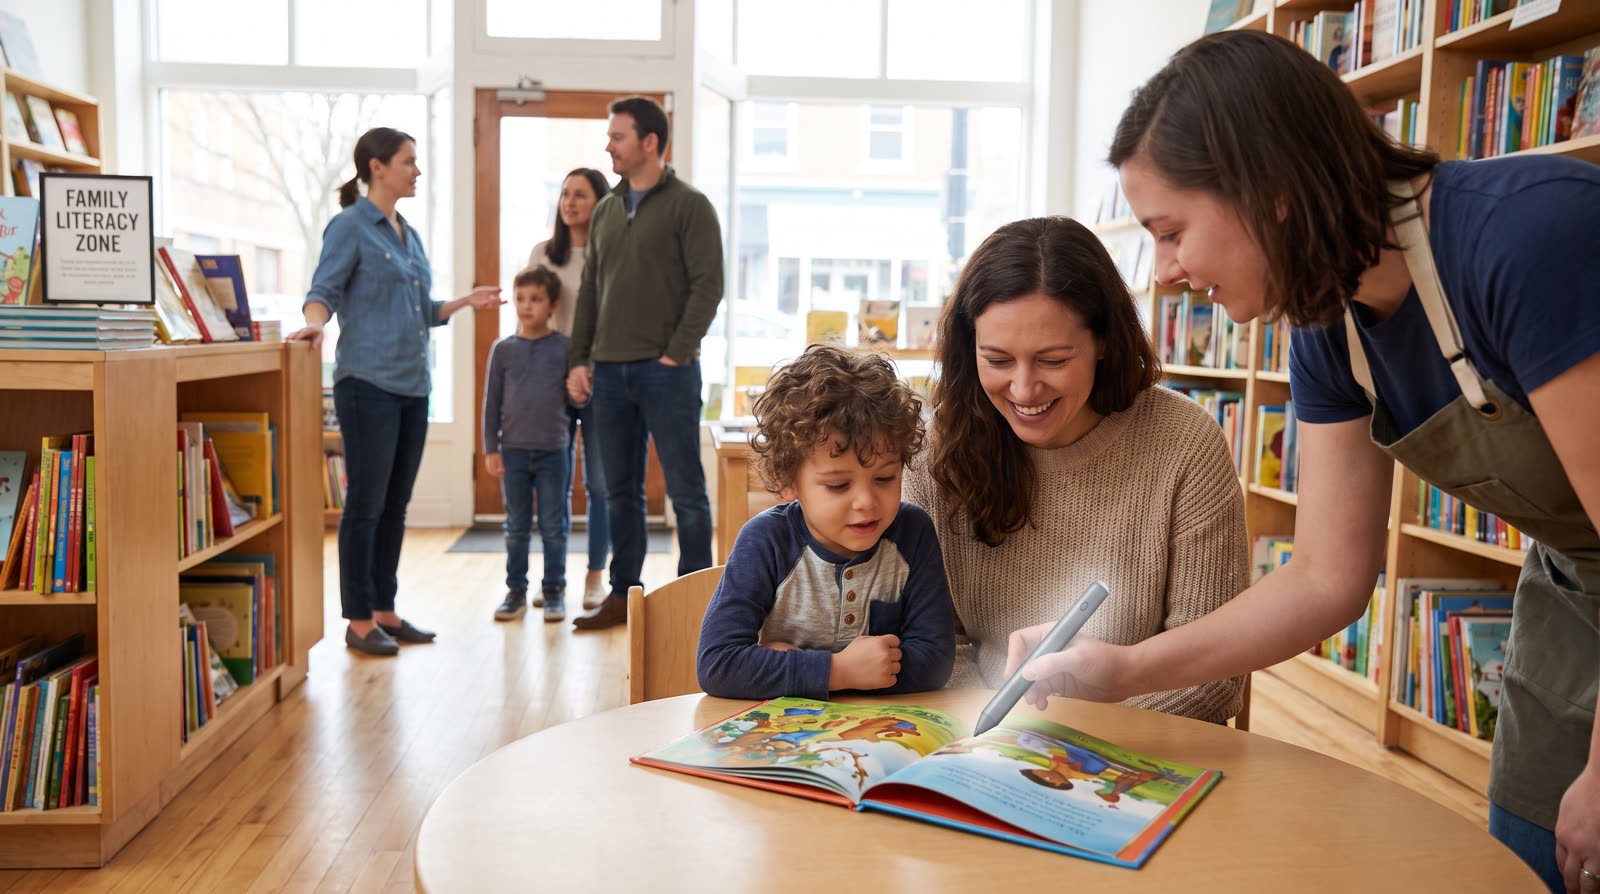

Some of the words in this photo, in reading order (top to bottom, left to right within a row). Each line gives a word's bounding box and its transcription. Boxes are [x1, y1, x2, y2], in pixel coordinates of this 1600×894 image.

[67, 189, 127, 208] FAMILY
[57, 212, 138, 230] LITERACY
[76, 234, 120, 252] ZONE
